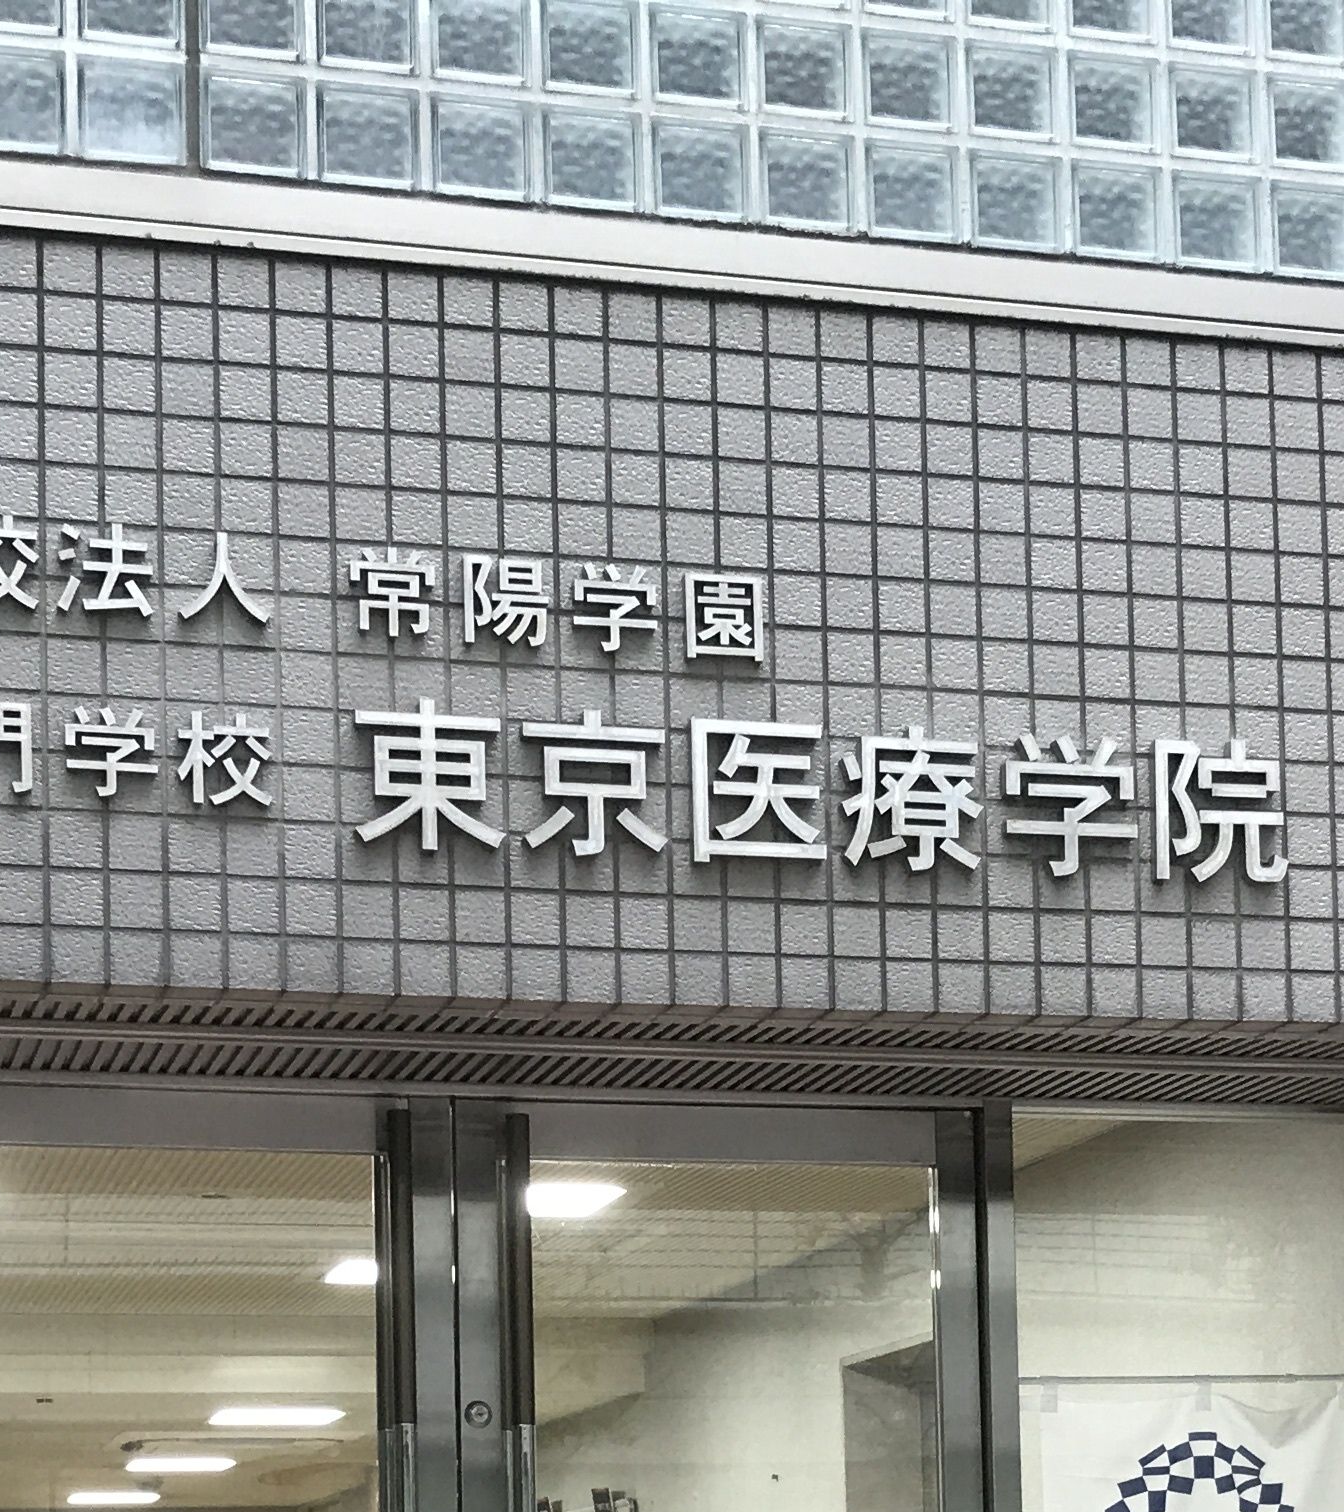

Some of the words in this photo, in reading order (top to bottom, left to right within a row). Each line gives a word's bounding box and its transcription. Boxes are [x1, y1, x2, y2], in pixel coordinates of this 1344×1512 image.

[347, 546, 767, 664] 常陽学園
[353, 696, 1290, 885] 東京医療学院
